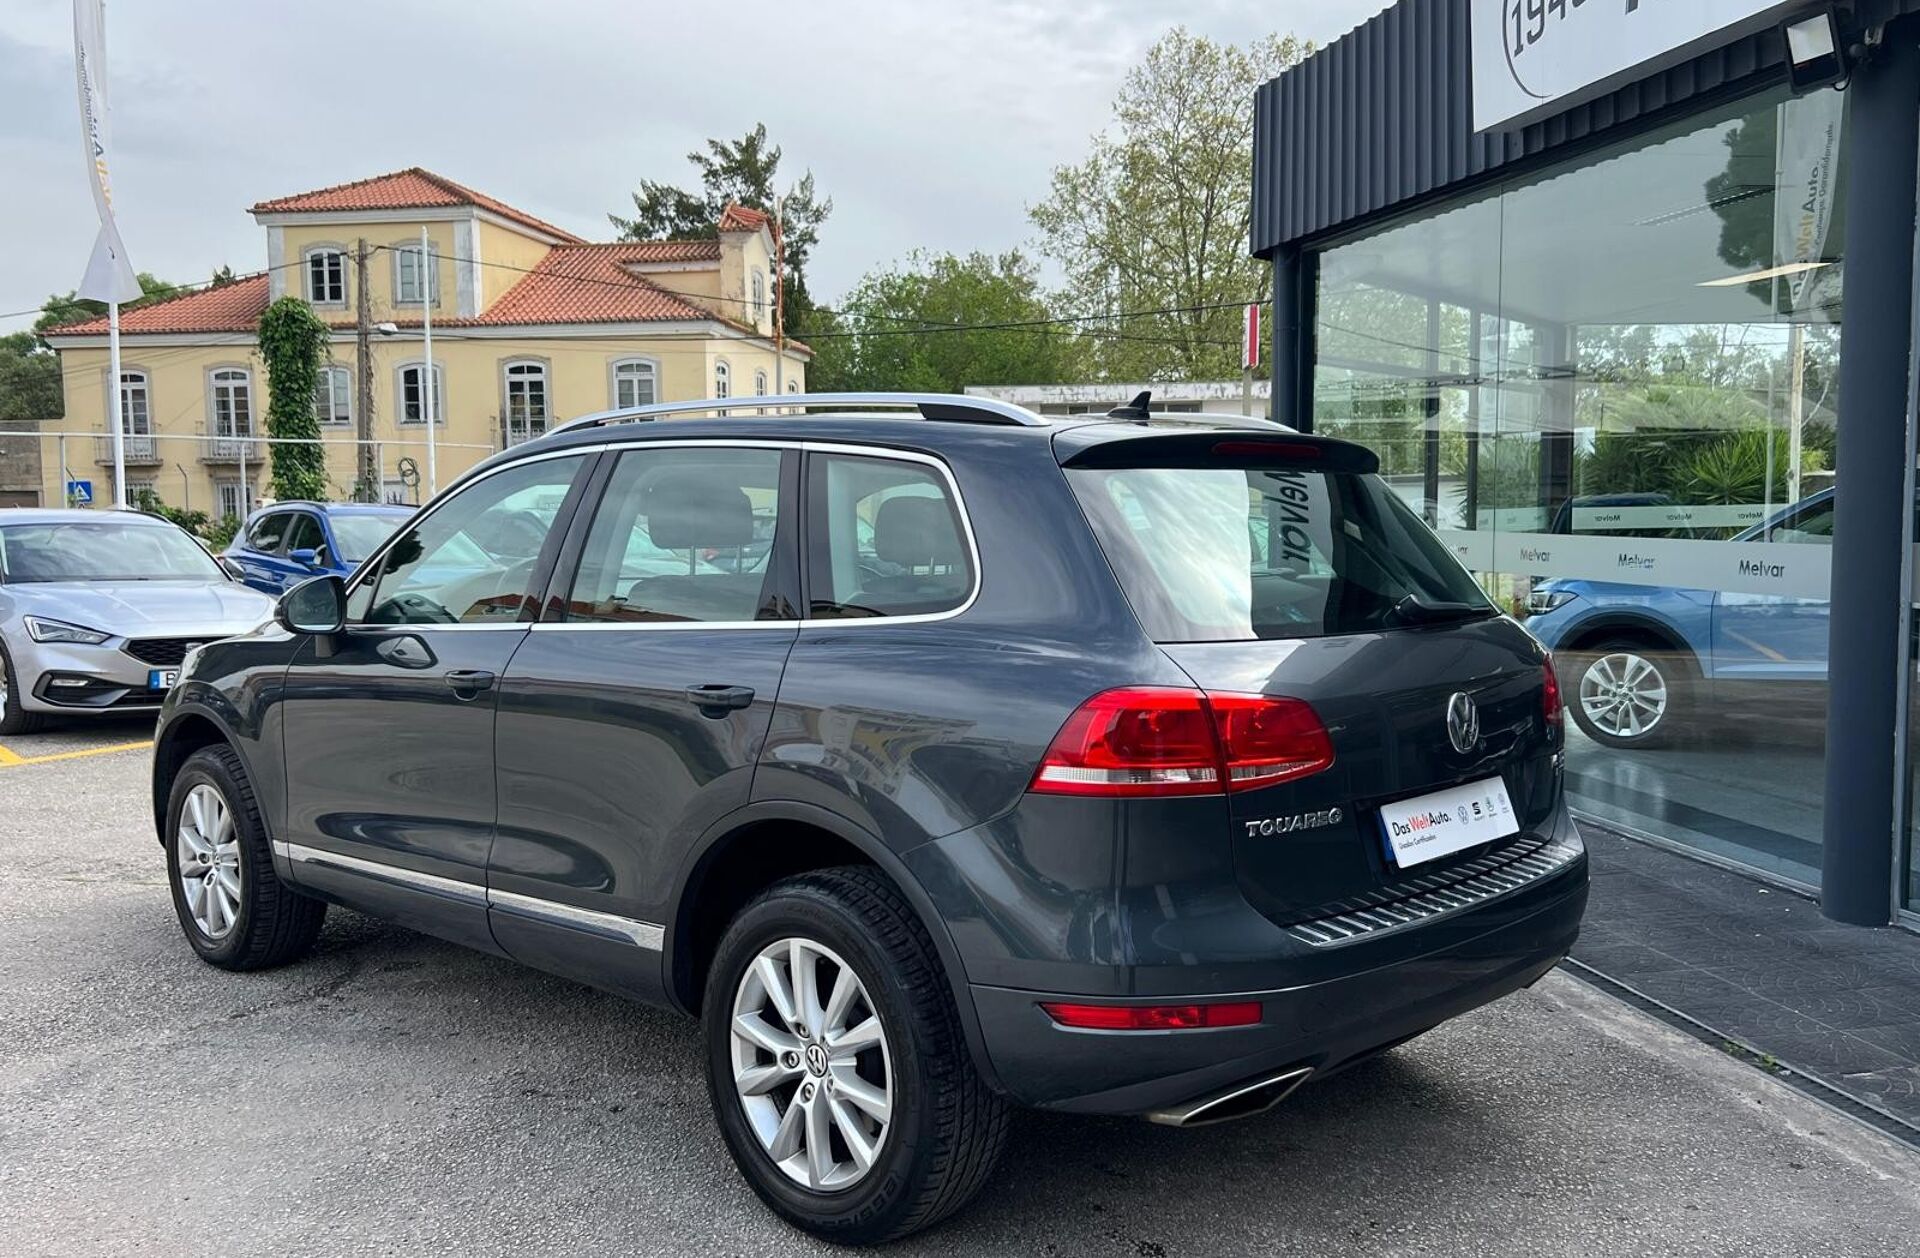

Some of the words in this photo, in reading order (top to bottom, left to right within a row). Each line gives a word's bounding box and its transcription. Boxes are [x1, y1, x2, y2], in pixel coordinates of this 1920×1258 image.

[1511, 0, 1587, 58] 19
[1520, 547, 1550, 563] Melvar
[1618, 553, 1656, 569] Melvar
[1738, 559, 1786, 578] Melvar
[1245, 807, 1343, 838] TOUAREG
